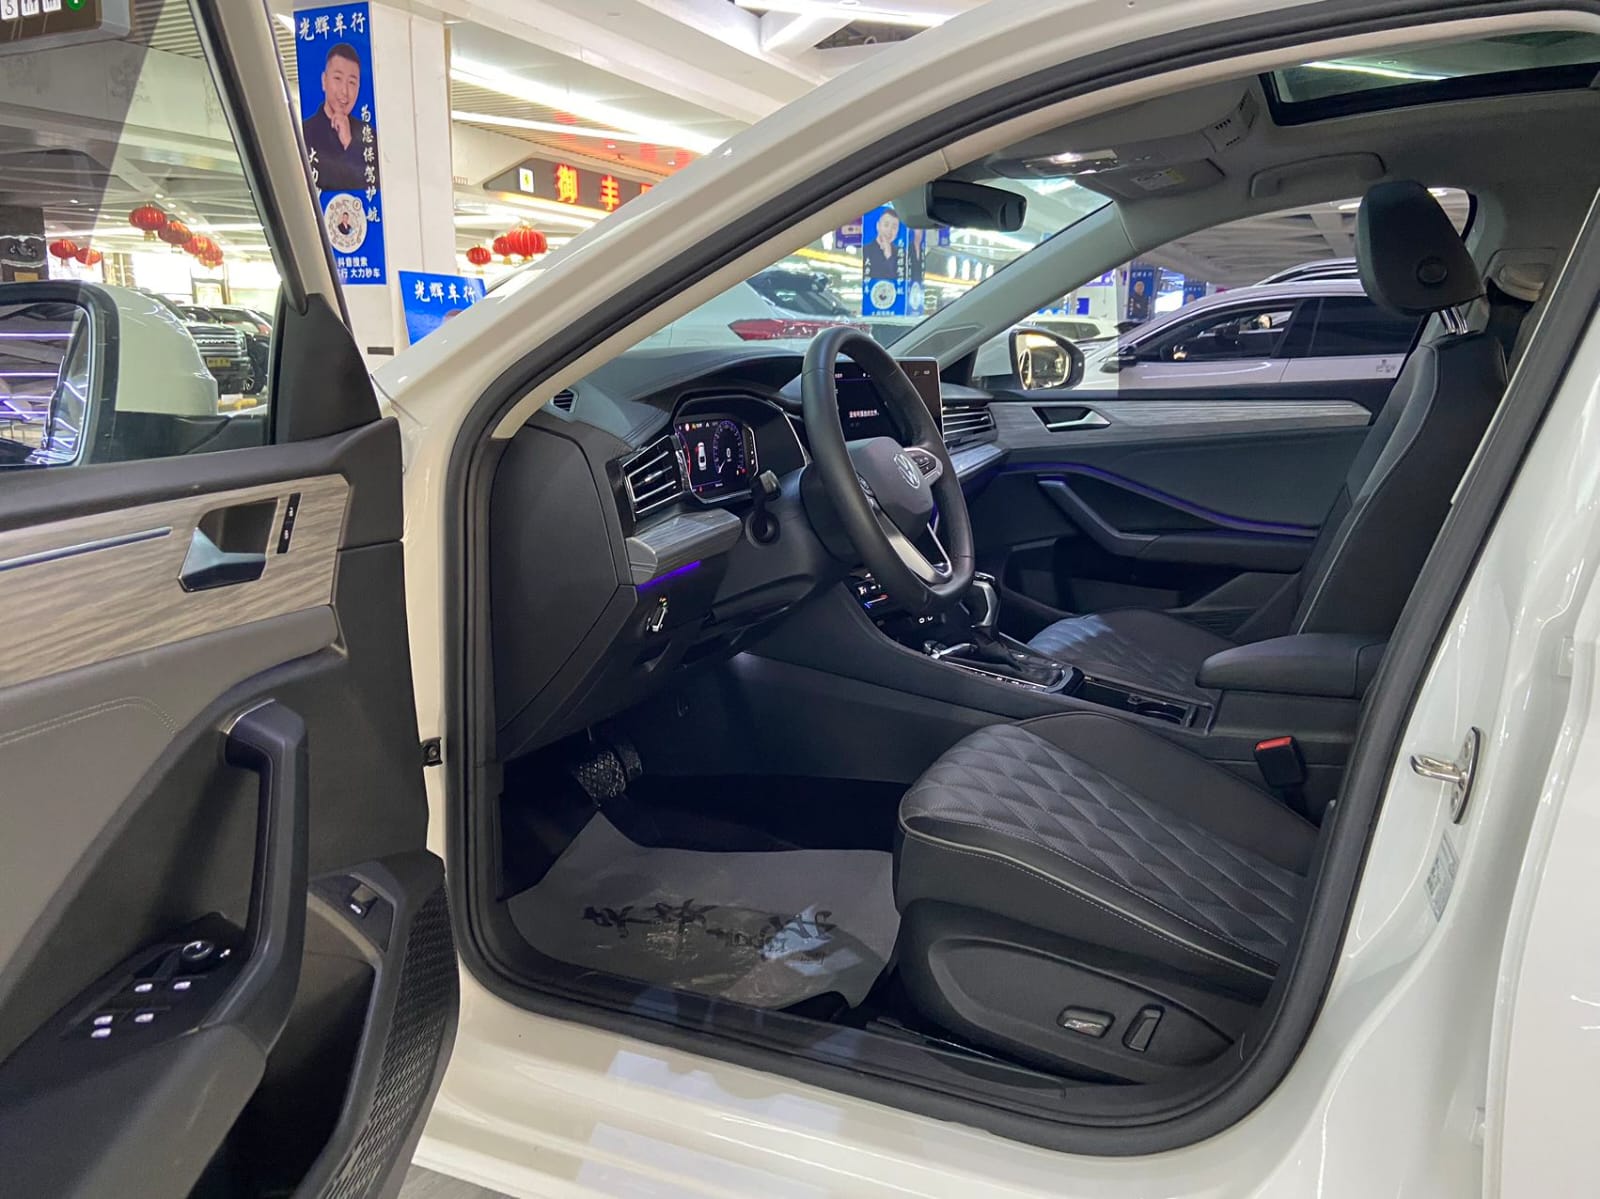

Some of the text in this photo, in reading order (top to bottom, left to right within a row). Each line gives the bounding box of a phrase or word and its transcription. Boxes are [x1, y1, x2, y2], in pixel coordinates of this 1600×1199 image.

[299, 12, 366, 41] 光辉车行
[361, 104, 380, 223] 为您保驾护航
[555, 163, 653, 212] 御丰
[414, 280, 476, 304] 光辉车行
